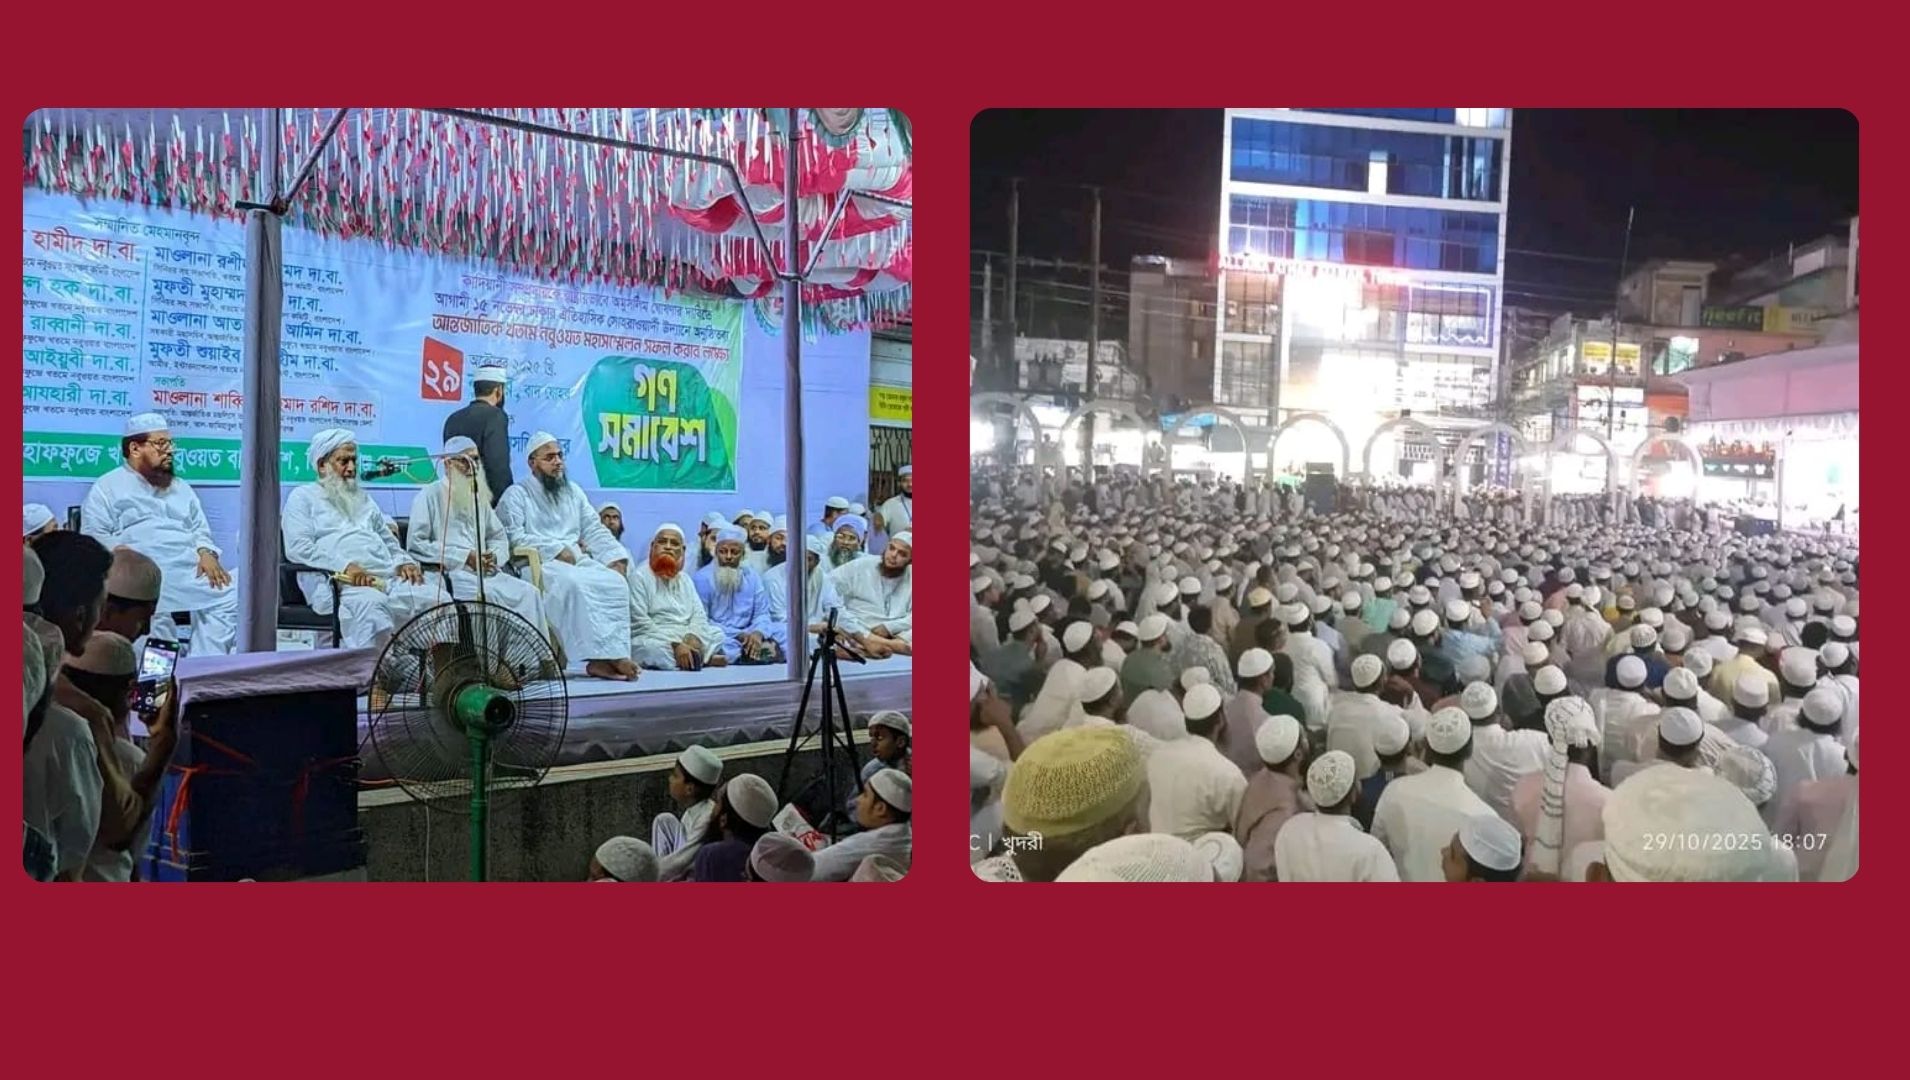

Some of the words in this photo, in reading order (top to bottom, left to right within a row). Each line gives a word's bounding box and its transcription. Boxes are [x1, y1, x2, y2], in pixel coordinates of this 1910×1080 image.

[32, 226, 88, 251] হামীদ
[94, 217, 141, 234] সম্মানিত
[143, 224, 201, 246] মেহমানবৃন্দ
[154, 246, 212, 267] মাওলানা
[48, 278, 81, 300] হক
[152, 277, 196, 301] মুফতী
[434, 290, 472, 309] আগামী
[474, 298, 488, 313] ১৫
[29, 313, 86, 335] রাব্বানী
[150, 309, 208, 330] মাওলানা
[212, 316, 243, 331] আত
[286, 321, 325, 340] আমিন
[148, 338, 192, 363] মুফতী
[506, 322, 538, 341] খতমে
[644, 338, 671, 355] সফল
[674, 342, 700, 359] করার
[424, 359, 460, 397] ২৯
[634, 363, 678, 413] গণ
[152, 390, 208, 409] মাওলানা
[598, 412, 706, 464] সমাবেশ
[23, 440, 104, 472] হাফফুজে
[174, 447, 225, 473] বুওয়ত
